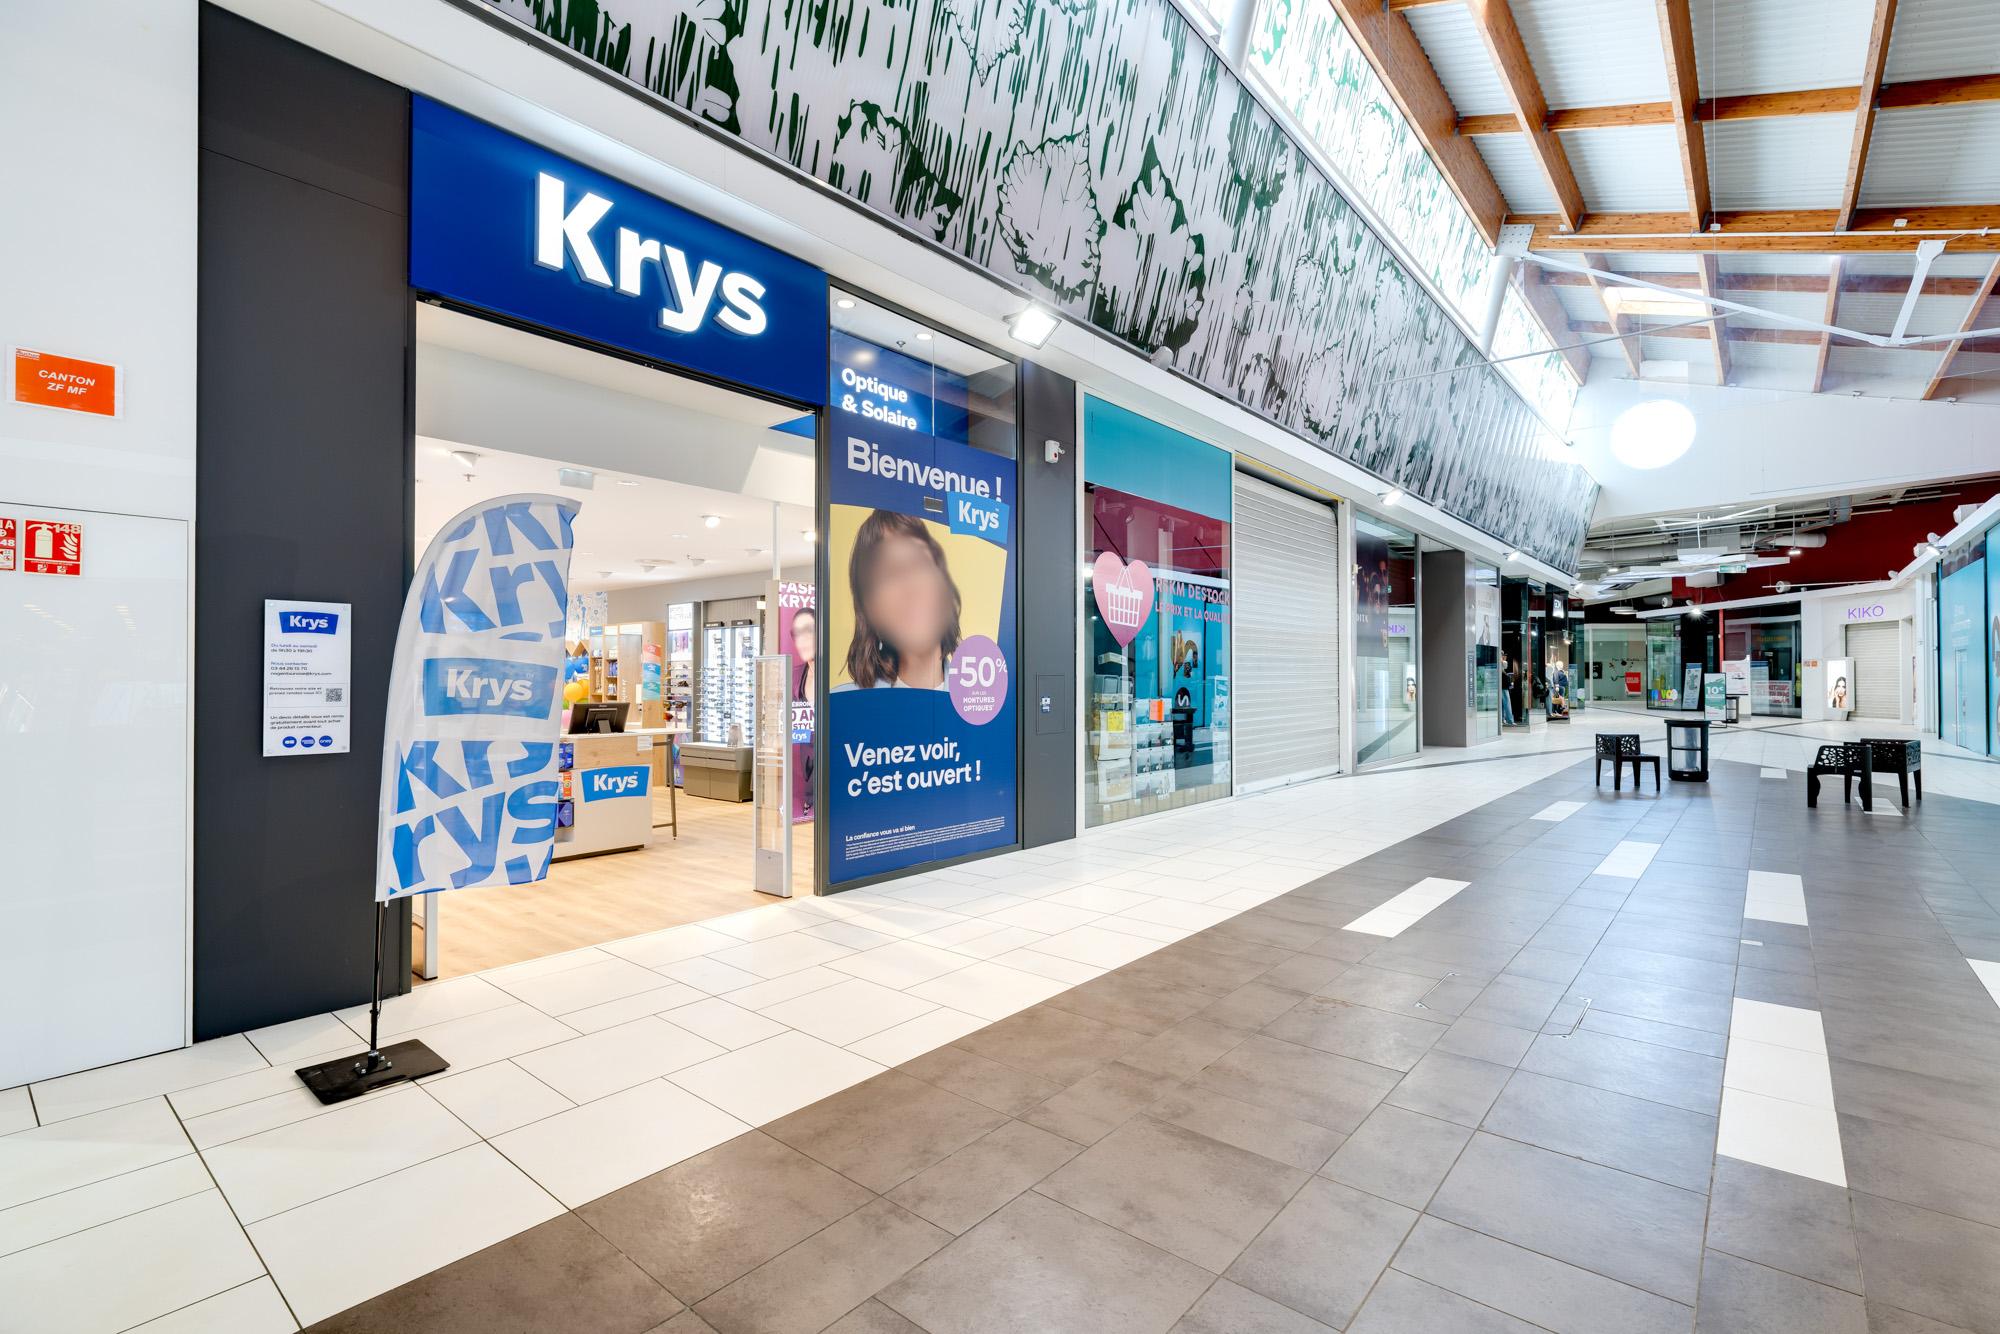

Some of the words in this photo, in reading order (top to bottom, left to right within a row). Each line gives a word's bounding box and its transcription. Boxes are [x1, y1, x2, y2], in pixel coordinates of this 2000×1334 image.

[534, 171, 767, 336] Krys
[38, 369, 96, 386] CANTON
[841, 367, 908, 403] Optique
[47, 382, 65, 391] ZF
[67, 385, 88, 395] MF
[841, 393, 859, 414] &
[861, 399, 918, 430] Solaire
[847, 436, 990, 499] Bienvenue
[958, 499, 1000, 532] Krys
[53, 524, 81, 534] 148
[289, 615, 329, 631] Krys
[1184, 606, 1193, 618] ET
[1194, 607, 1203, 620] LA
[1847, 605, 1884, 620] KIKO
[446, 668, 533, 707] Krys
[962, 696, 995, 704] MONTURES
[844, 742, 916, 768] Venez
[919, 736, 961, 762] voir,
[593, 773, 639, 794] Krys
[847, 770, 903, 797] c’est
[906, 763, 972, 790] ouvert
[853, 831, 880, 841] confiance
